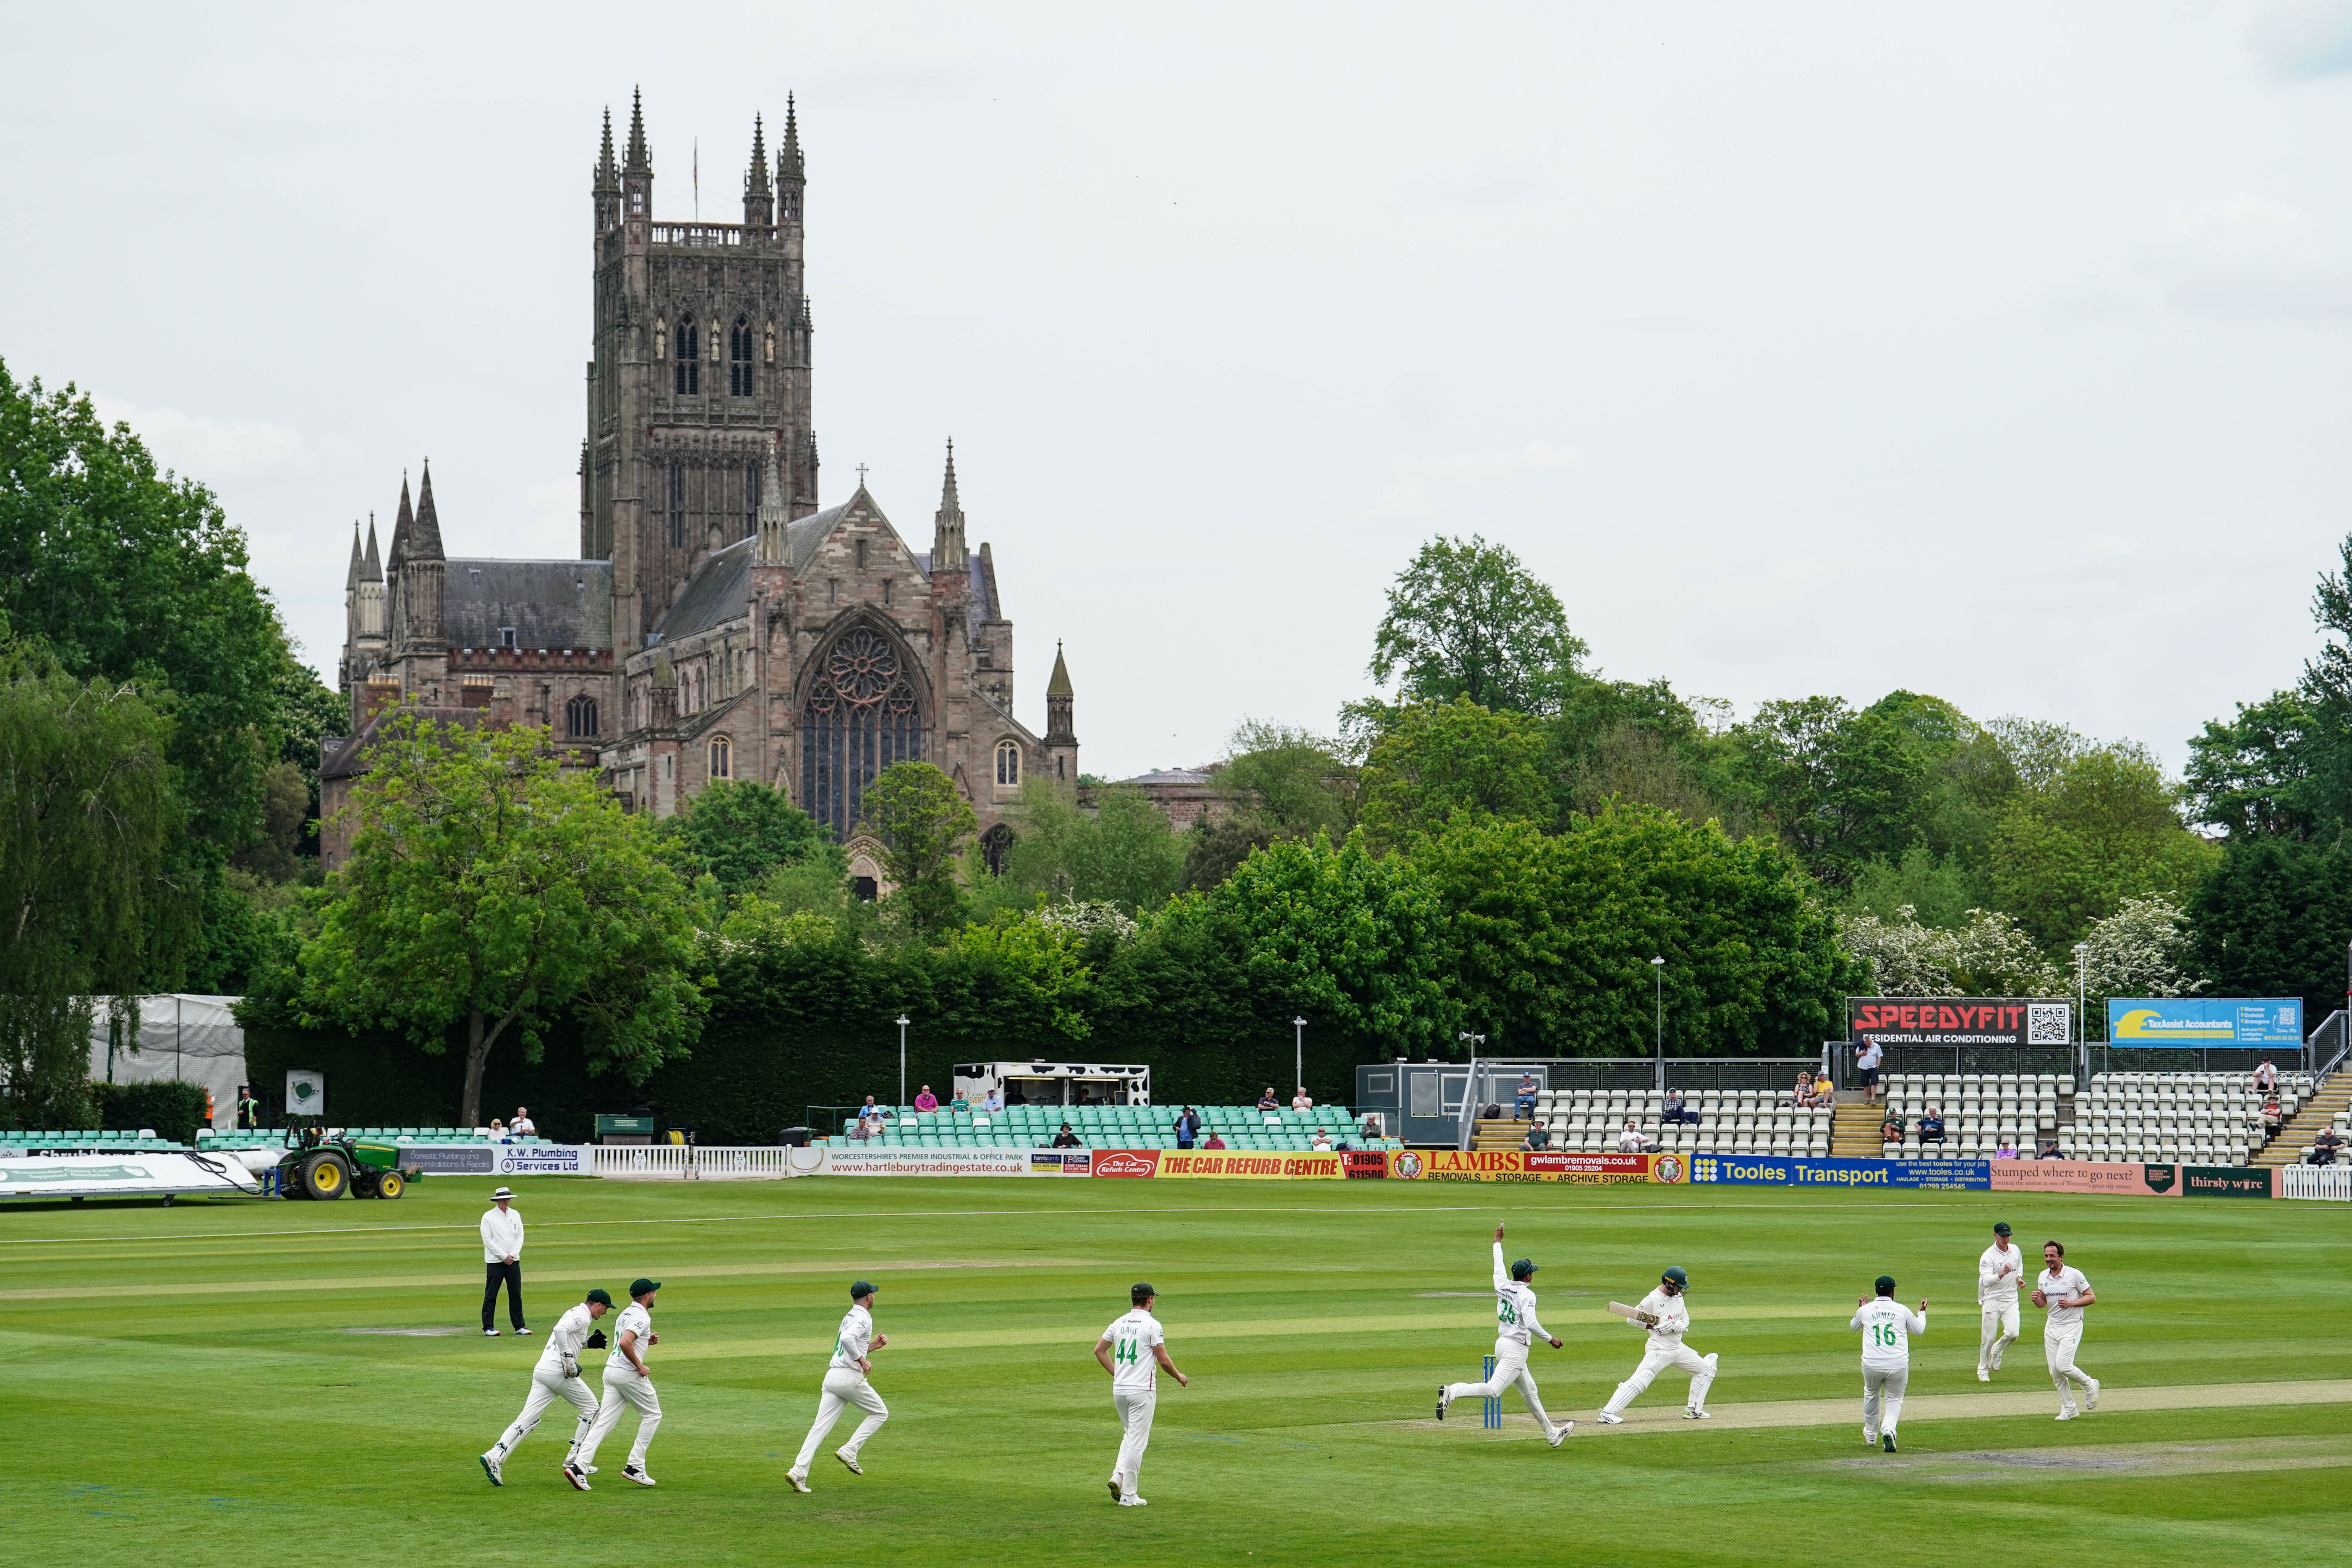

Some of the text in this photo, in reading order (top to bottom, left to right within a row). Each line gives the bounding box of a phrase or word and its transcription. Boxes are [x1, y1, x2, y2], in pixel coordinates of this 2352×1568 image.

[1855, 1006, 2026, 1030] SPEEDYFIT
[2148, 1019, 2233, 1028] TaxAssist Accountants
[1925, 1035, 1942, 1043] AIR
[1943, 1034, 2017, 1043] CONDITIONING
[533, 1149, 578, 1158] Plumbing
[1342, 1154, 1383, 1165] T: 01905
[1429, 1151, 1519, 1171] LAMBS
[1531, 1155, 1637, 1166] gwlambremovals.co.uk
[517, 1162, 578, 1170] Services Ltd
[832, 1162, 1023, 1174] www.hartleburytradingestate.co.uk
[1165, 1158, 1338, 1175] THE CAR REFURB CENTRE
[1349, 1170, 1383, 1179] 611500
[1428, 1172, 1648, 1183] REMOVALS STORAGE ARCHIVE STORAGE
[1722, 1162, 1888, 1186] Tooles Transport
[1991, 1166, 2039, 1180] Stumped
[2043, 1166, 2074, 1177] where
[2090, 1172, 2102, 1183] go
[2107, 1170, 2133, 1180] next?
[2190, 1176, 2229, 1190] thirsty
[1871, 1312, 1895, 1320] AHMED
[1121, 1326, 1138, 1335] DAVIS
[1872, 1323, 1896, 1346] 16
[1116, 1338, 1137, 1365] 44
